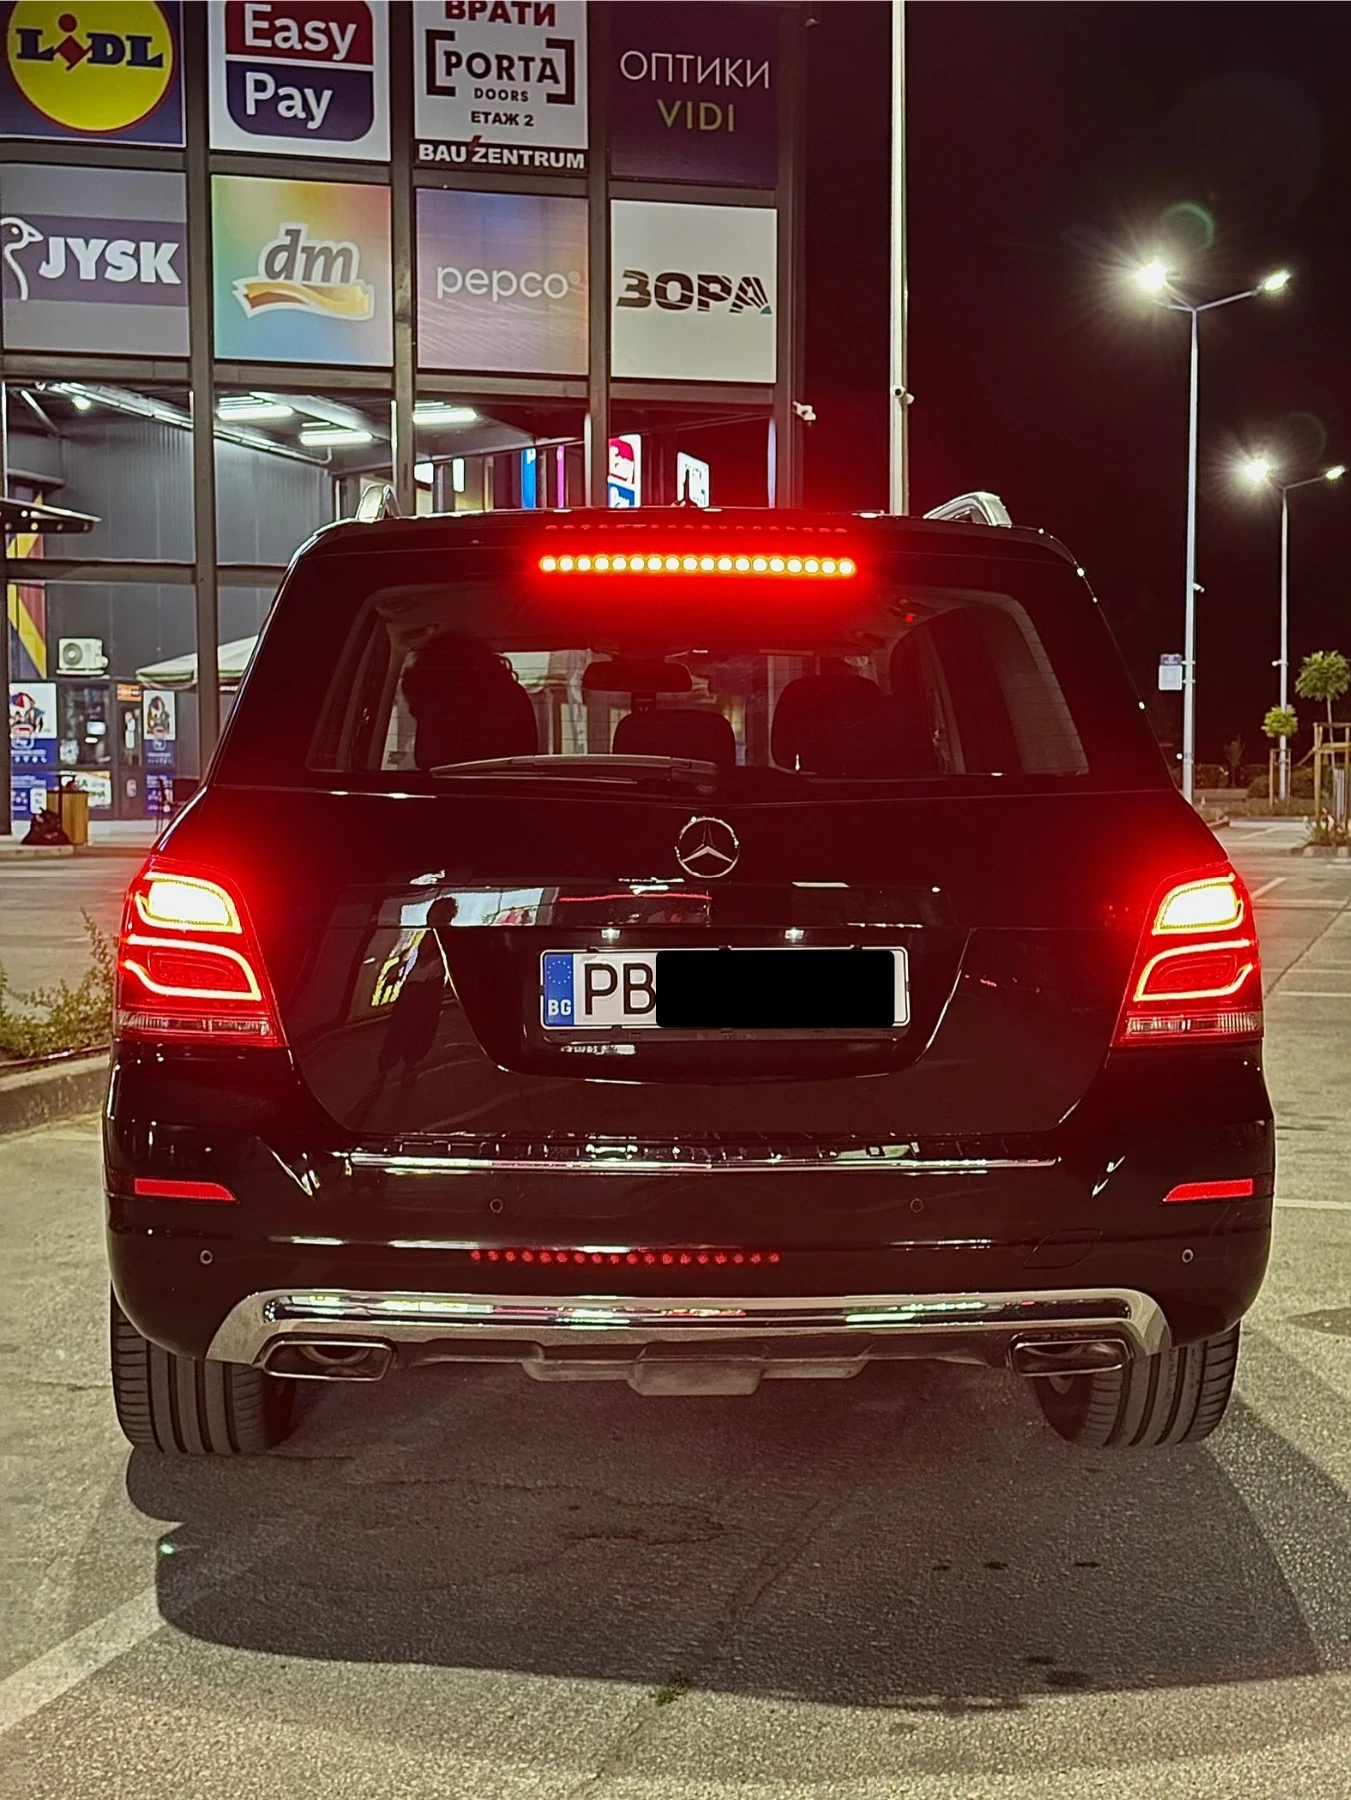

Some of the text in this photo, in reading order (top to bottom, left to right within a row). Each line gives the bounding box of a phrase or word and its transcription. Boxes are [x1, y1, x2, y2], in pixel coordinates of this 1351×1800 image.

[445, 0, 556, 27] ВРАТИ
[244, 3, 357, 62] Easy
[443, 50, 560, 84] PORTA
[620, 50, 770, 89] ОПТИКИ
[245, 71, 333, 129] Pay
[474, 88, 529, 102] DOORS
[471, 111, 534, 127] ЕТАЖ 2
[657, 99, 735, 132] VIDI
[418, 144, 584, 169] BAU ZENTRUM
[39, 237, 181, 284] JYSK
[265, 229, 358, 284] dm
[616, 269, 772, 315] ЗОРА
[548, 999, 571, 1015] BG
